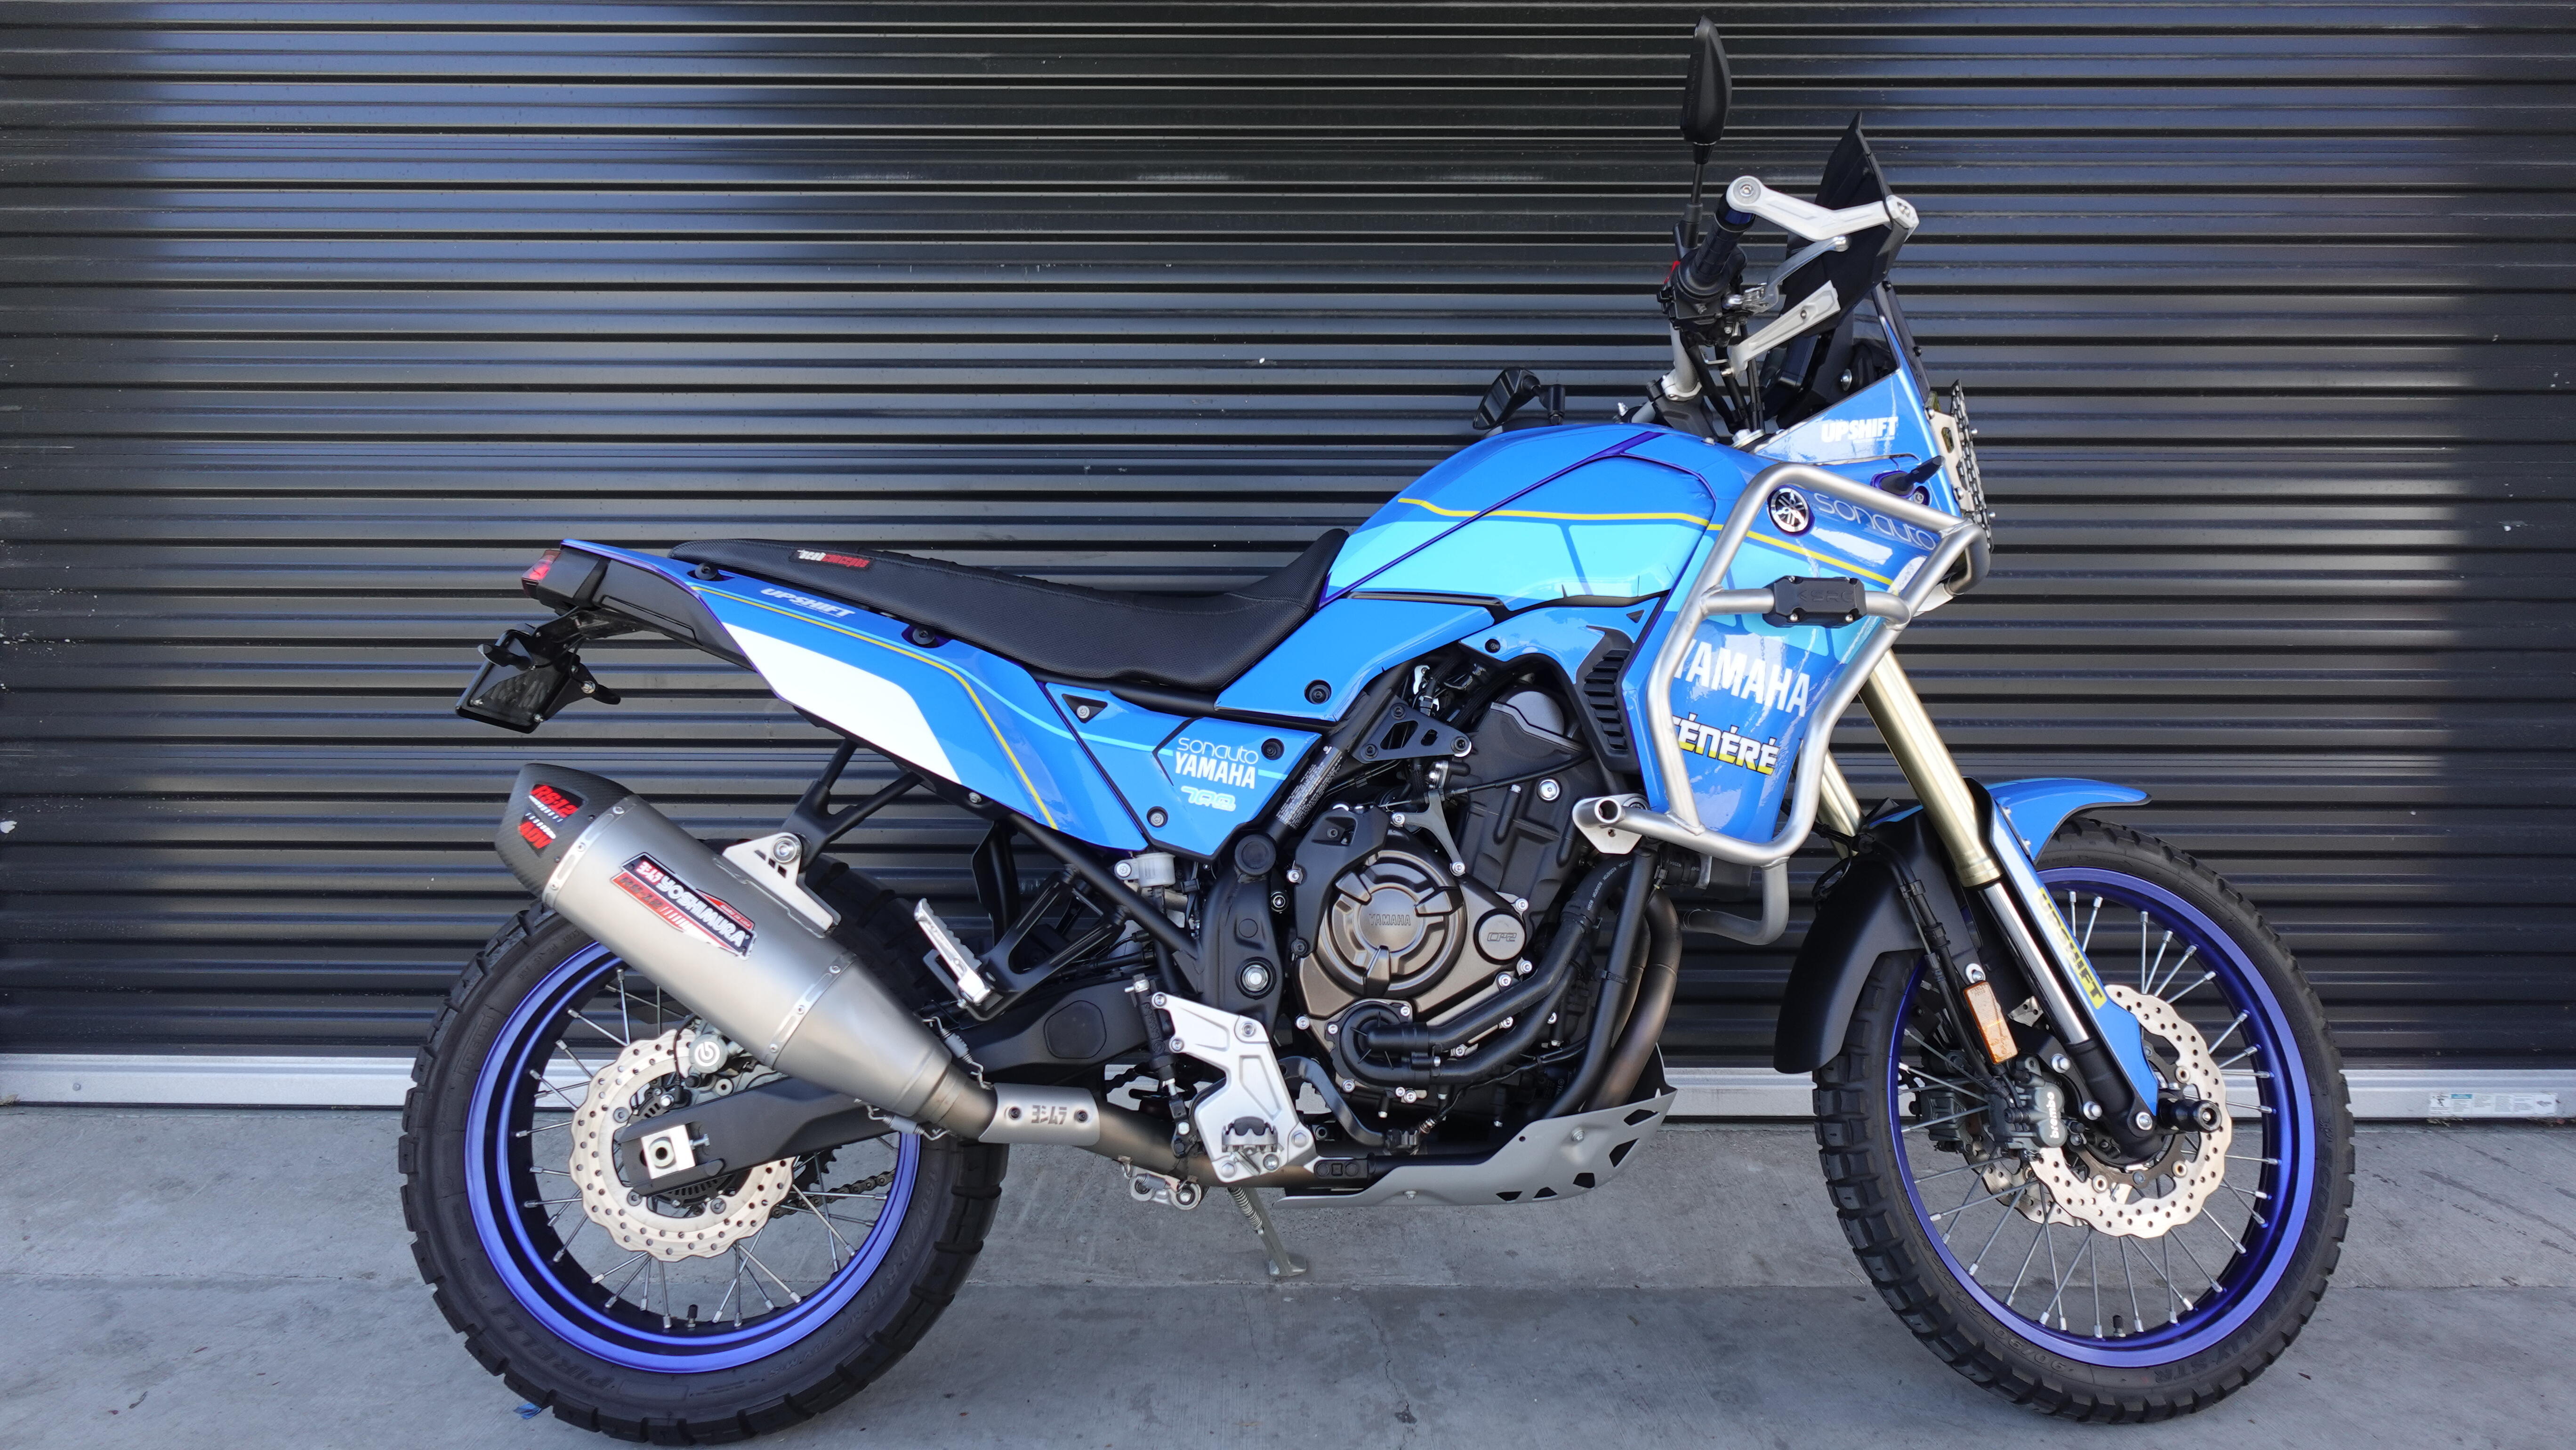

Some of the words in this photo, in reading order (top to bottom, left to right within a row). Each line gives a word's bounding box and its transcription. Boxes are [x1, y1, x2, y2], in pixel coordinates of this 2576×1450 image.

[1821, 416, 1899, 443] UPSHIFT
[1814, 492, 1936, 550] sonauto
[760, 588, 856, 617] UPSHIFT
[1177, 737, 1259, 765] sonauto
[1672, 711, 1781, 776] ÉNÉRÉ
[1175, 751, 1256, 789] YAMAHA
[518, 821, 553, 849] ADV
[655, 875, 747, 948] YOSHIMURA
[1368, 913, 1411, 926] YAMAHA
[1487, 932, 1517, 942] CP2
[1031, 1104, 1068, 1125] ヨシムラ
[2046, 1092, 2060, 1138] brembo
